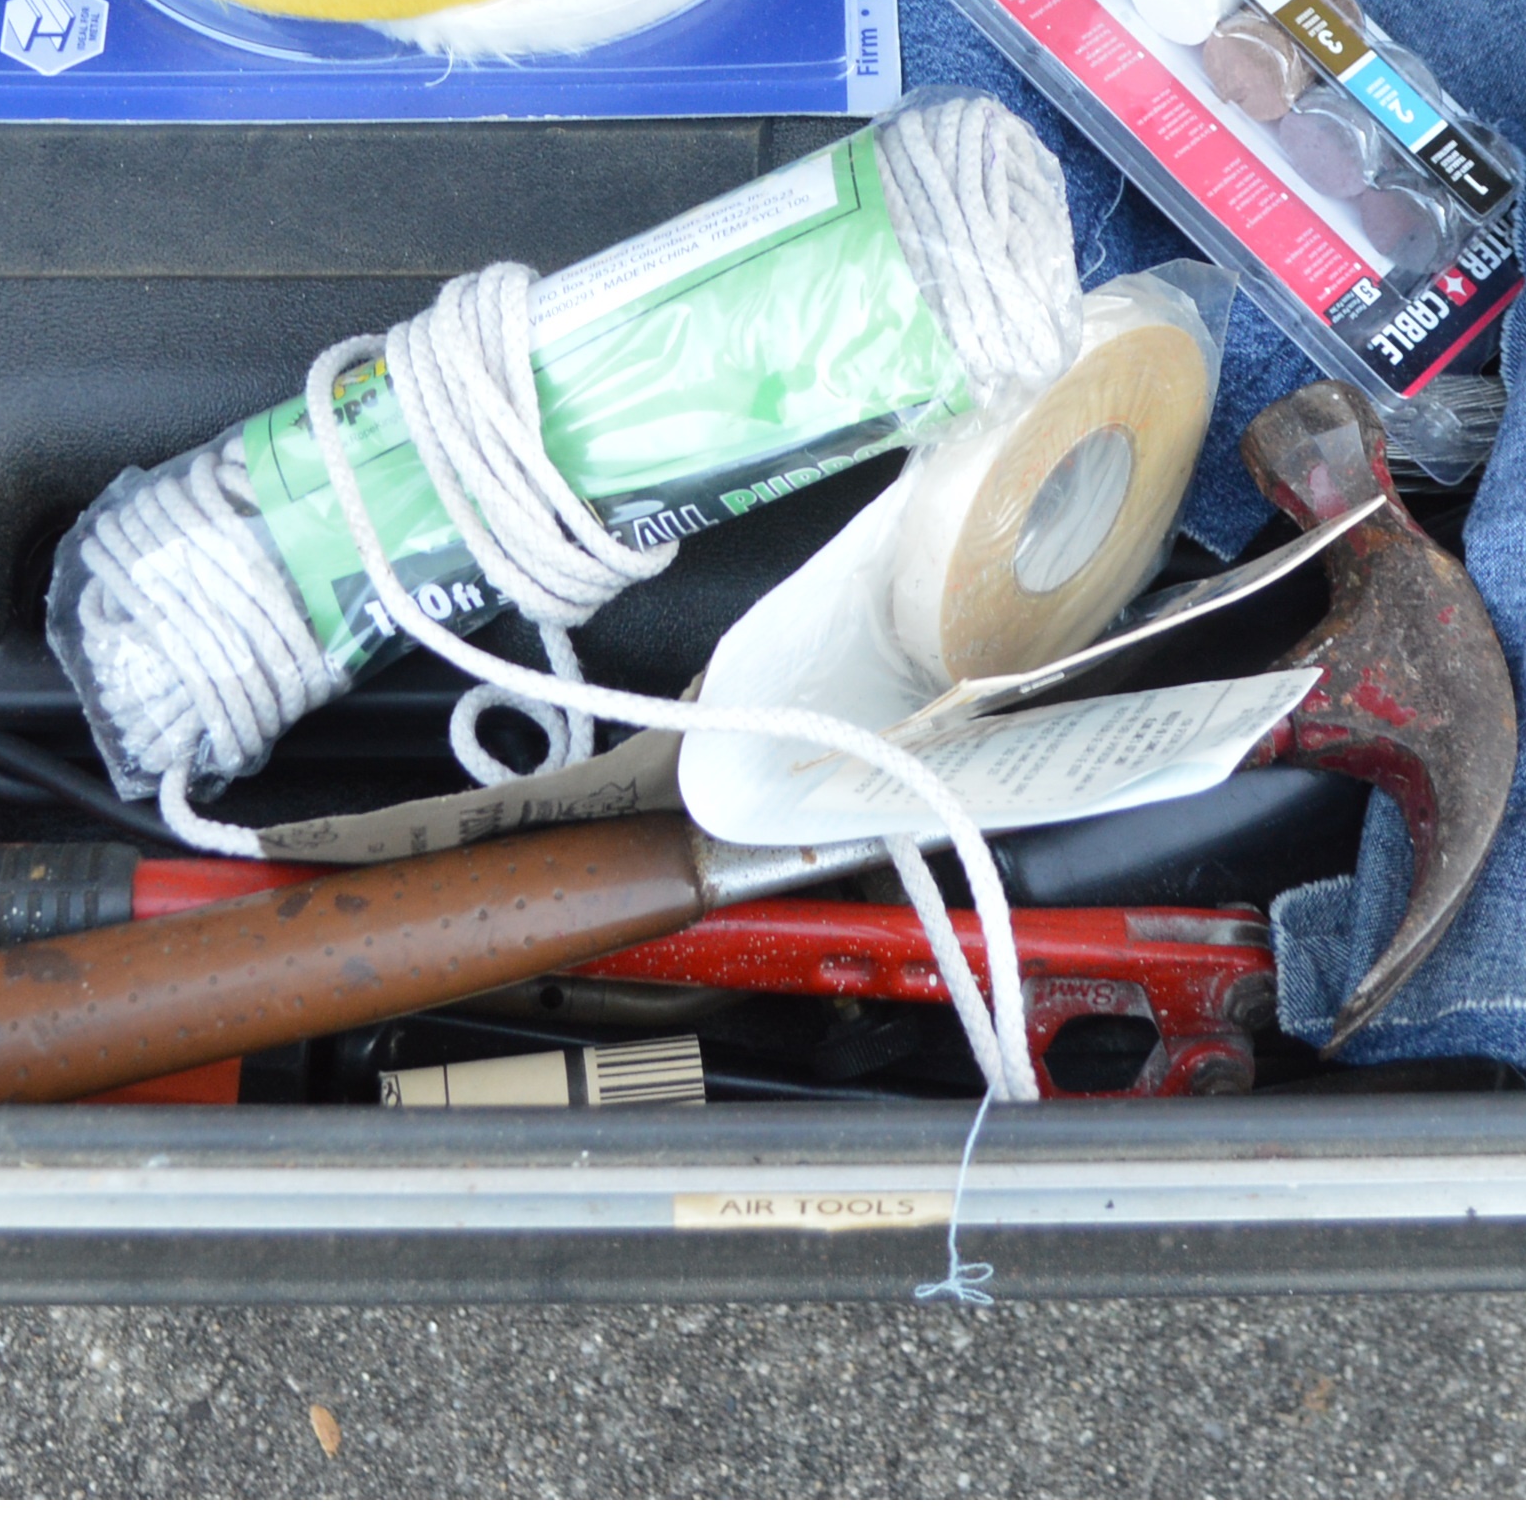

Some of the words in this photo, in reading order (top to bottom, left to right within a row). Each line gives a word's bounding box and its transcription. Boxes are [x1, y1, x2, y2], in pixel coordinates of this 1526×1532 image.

[77, 25, 88, 50] IDEAL
[89, 14, 100, 41] METAL
[1317, 25, 1343, 54] 3
[857, 27, 879, 77] Firm
[1388, 98, 1414, 123] 2
[1464, 174, 1488, 195] 1
[559, 247, 628, 282] Distributed
[563, 281, 584, 294] Box
[699, 220, 717, 233] OH
[604, 268, 638, 290] MADE
[643, 260, 655, 271] IN
[659, 242, 699, 264] CHINA
[712, 220, 748, 241] ITEM#
[1360, 285, 1373, 298] 5
[1371, 285, 1449, 365] CABLE
[632, 504, 719, 555] ALL
[719, 1199, 774, 1216] AIR
[794, 1198, 915, 1216] TOOLS
